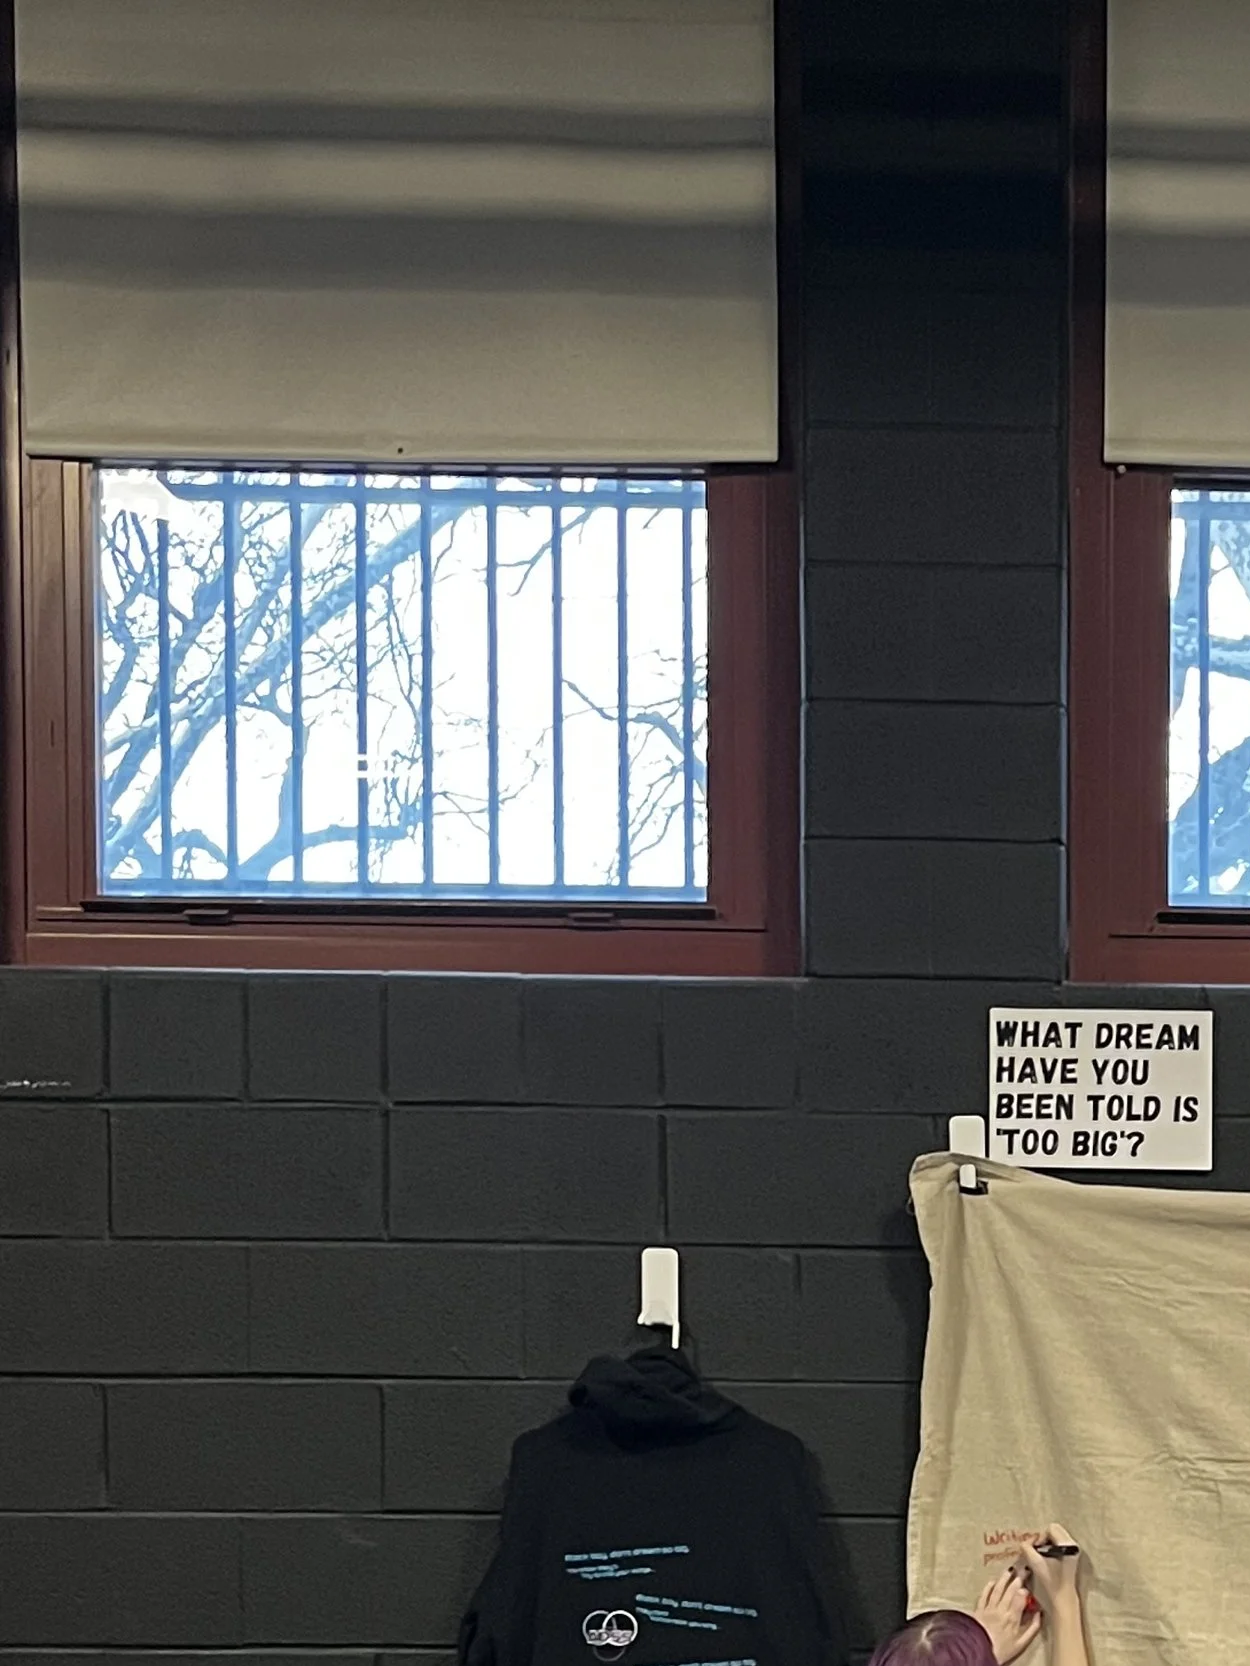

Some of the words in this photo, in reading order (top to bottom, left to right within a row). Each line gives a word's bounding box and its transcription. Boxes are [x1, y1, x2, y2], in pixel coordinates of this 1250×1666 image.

[996, 1021, 1082, 1048] WHAT
[1096, 1023, 1199, 1050] DREAM
[996, 1057, 1078, 1084] HAVE
[1092, 1059, 1148, 1085] YOU
[996, 1093, 1073, 1120] BEEN
[1087, 1095, 1160, 1121] TOLD
[1174, 1096, 1198, 1122] IS
[1072, 1131, 1144, 1157] BIG'?
